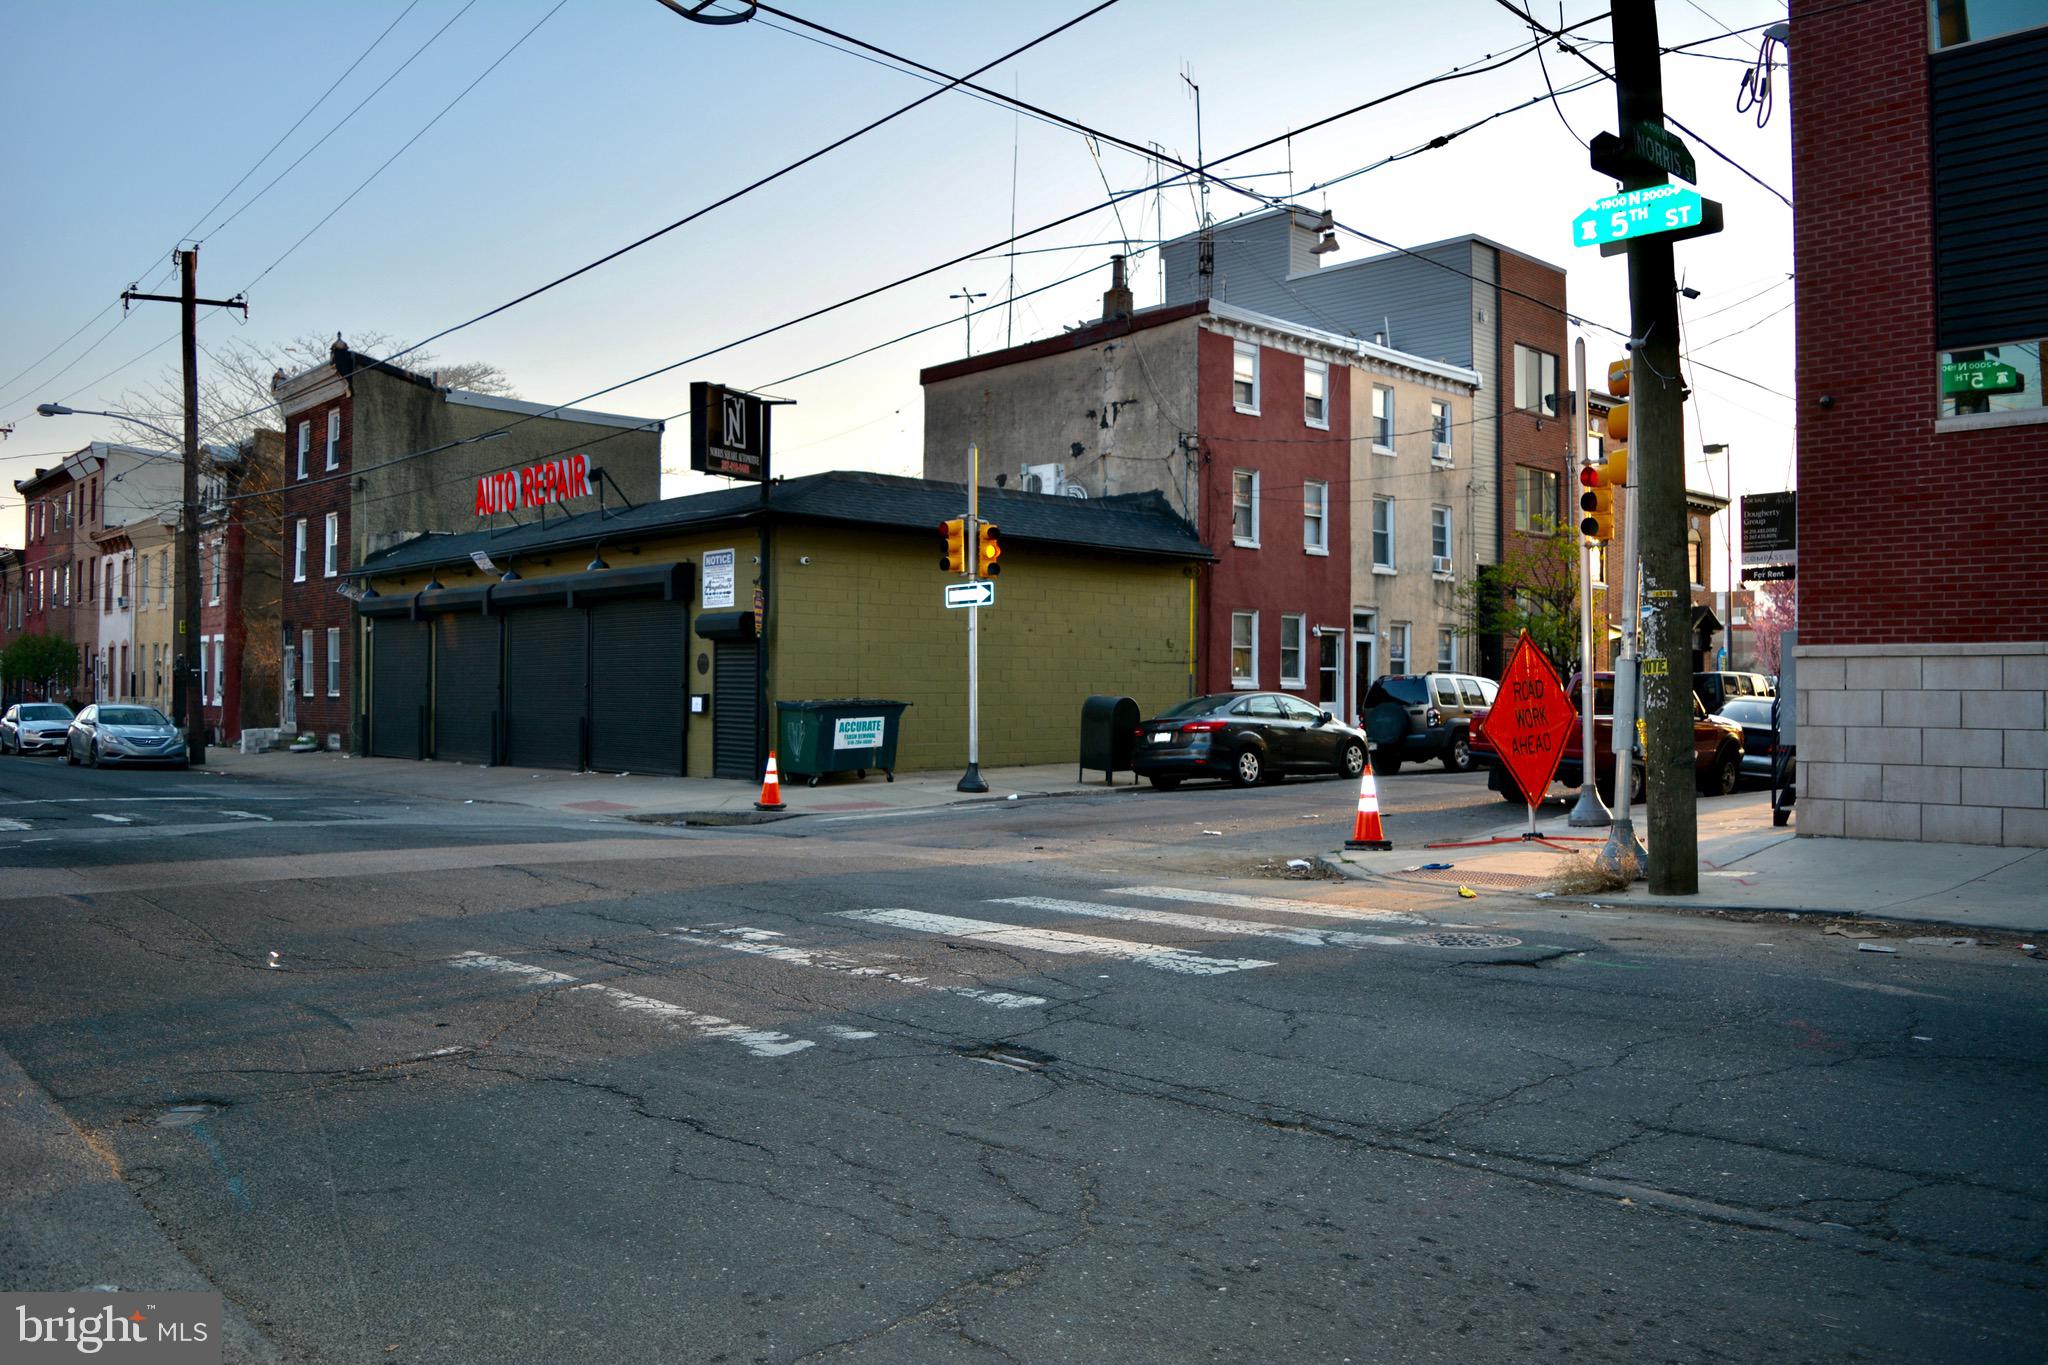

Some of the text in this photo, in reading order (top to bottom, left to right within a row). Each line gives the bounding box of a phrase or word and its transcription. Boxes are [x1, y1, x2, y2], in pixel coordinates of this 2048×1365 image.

[1636, 128, 1681, 175] NORRIS
[1601, 188, 1671, 209] 1900 N 2000
[1610, 205, 1691, 237] 5TH ST
[475, 454, 592, 516] AUTO REPAIR
[1743, 509, 1780, 519] Dougherty
[1743, 518, 1766, 526] Group
[706, 553, 733, 566] NOTICE
[1744, 554, 1784, 562] COMPASS
[1753, 570, 1785, 579] For Rent
[1513, 679, 1544, 701] ROAD
[839, 720, 881, 733] ACCURATE
[1515, 708, 1549, 728] WORK
[1511, 732, 1552, 754] AHEAD
